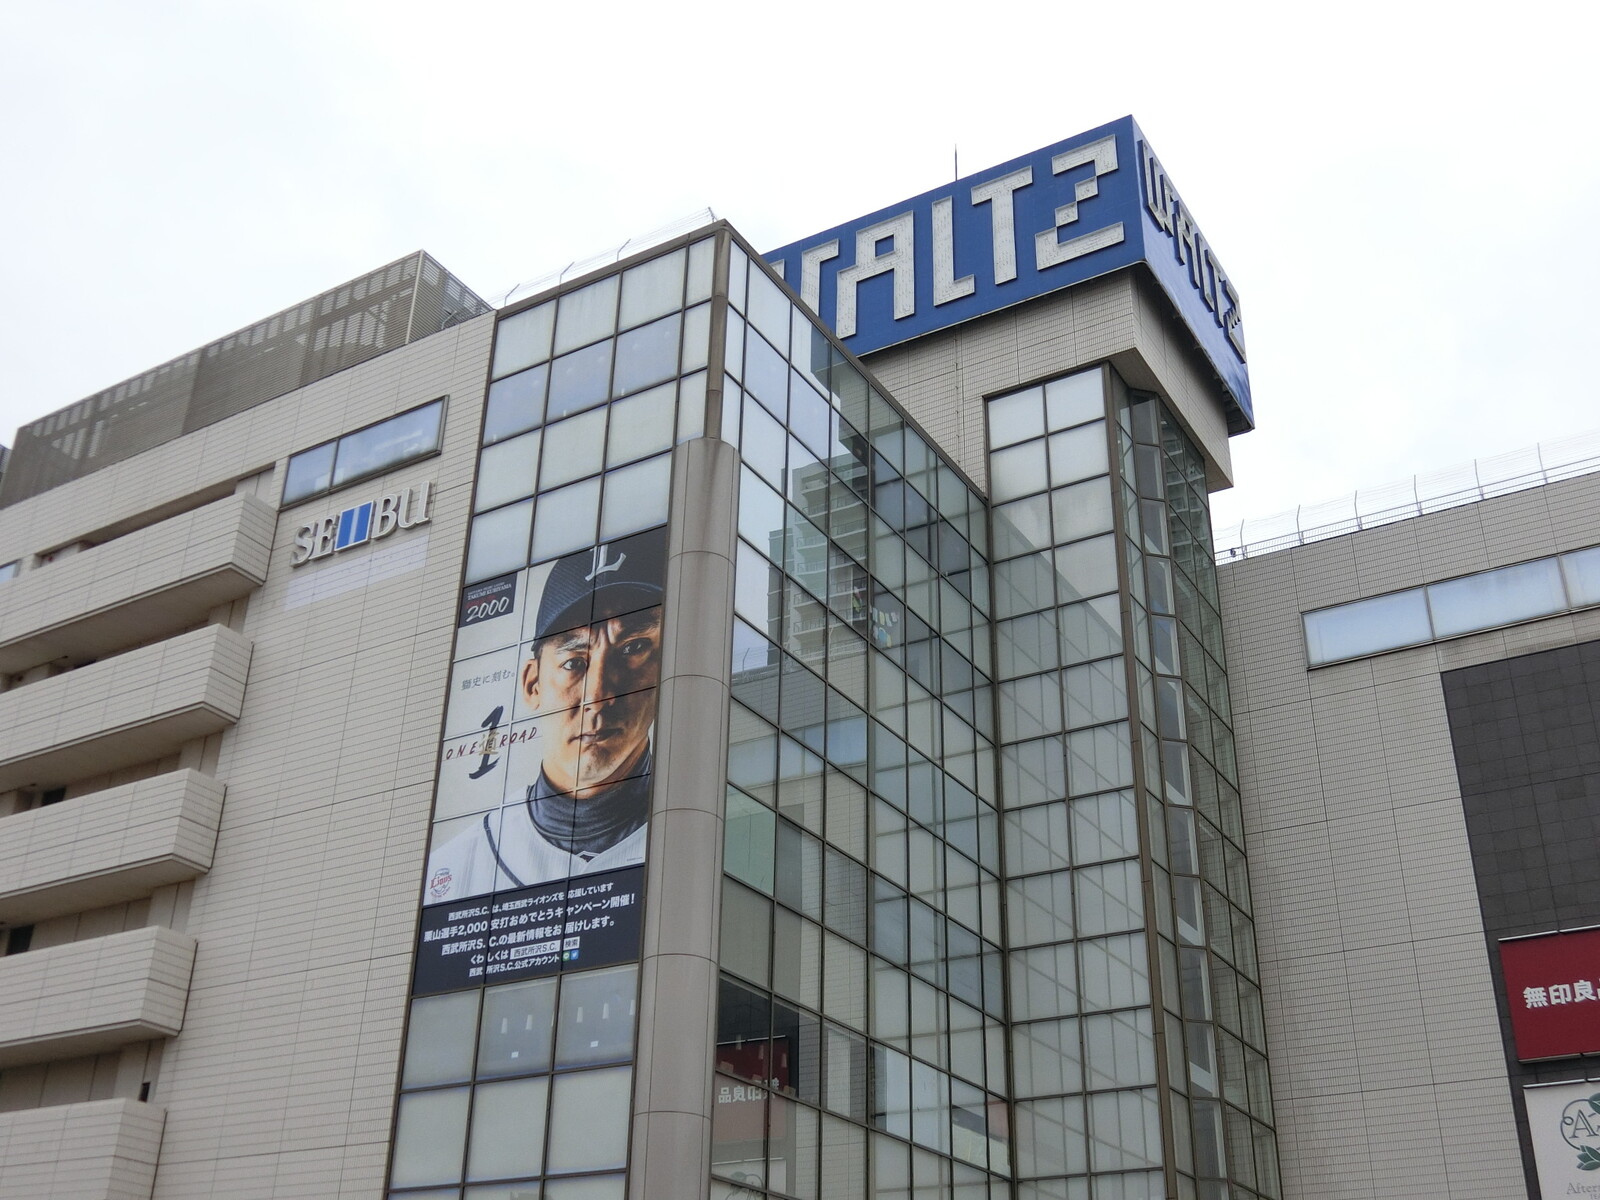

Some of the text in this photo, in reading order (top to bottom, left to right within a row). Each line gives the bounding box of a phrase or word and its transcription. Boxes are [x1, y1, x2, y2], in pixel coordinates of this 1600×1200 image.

[1137, 139, 1246, 364] WALTZ
[466, 596, 509, 622] 2000
[446, 741, 478, 760] ONE
[499, 726, 537, 748] ROAD
[470, 949, 509, 965] くわしくは
